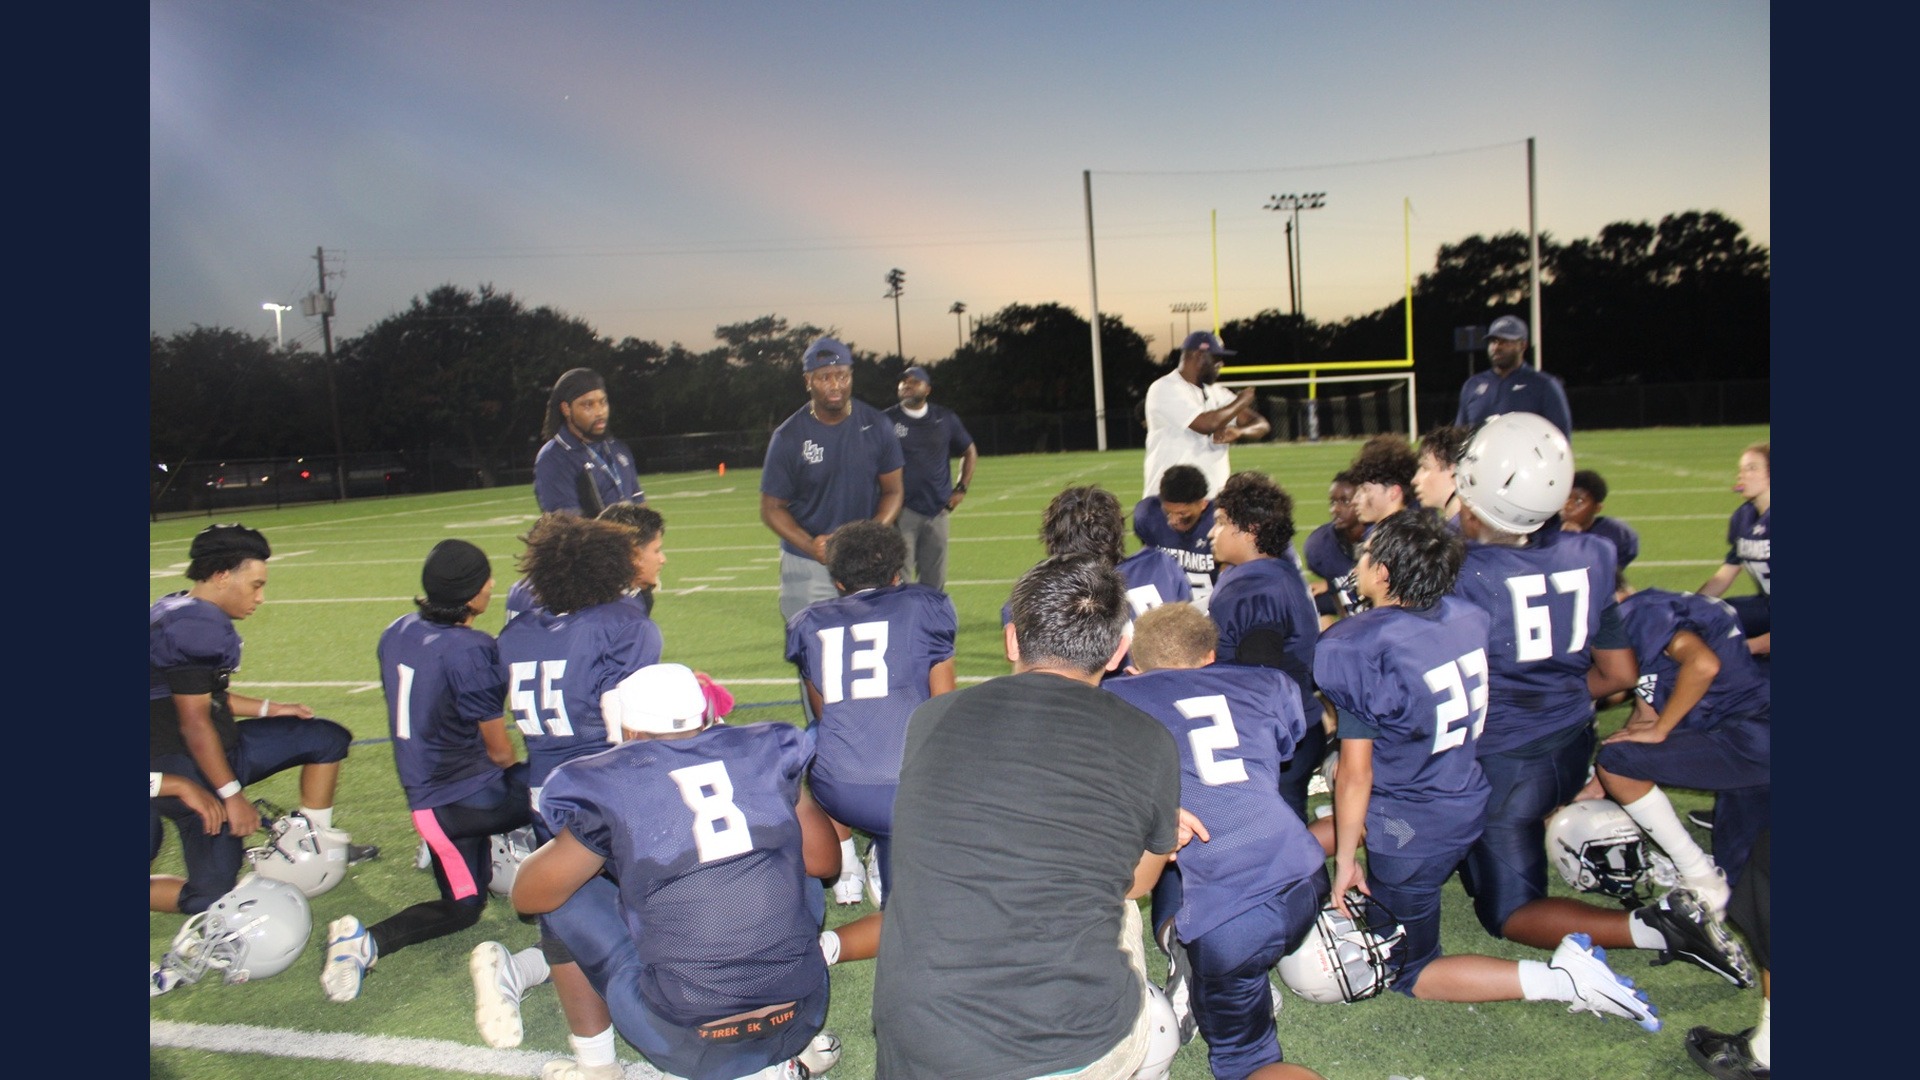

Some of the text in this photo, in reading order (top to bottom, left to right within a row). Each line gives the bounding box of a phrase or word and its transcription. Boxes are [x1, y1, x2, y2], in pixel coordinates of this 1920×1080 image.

[1504, 567, 1590, 662] 67
[396, 663, 415, 740] 1
[509, 659, 574, 736] 55
[816, 621, 889, 704] 13
[1423, 648, 1489, 754] 23
[1173, 695, 1249, 786] 2
[668, 760, 753, 863] 8
[711, 1026, 739, 1038] TREK
[770, 1010, 795, 1026] TUFF
